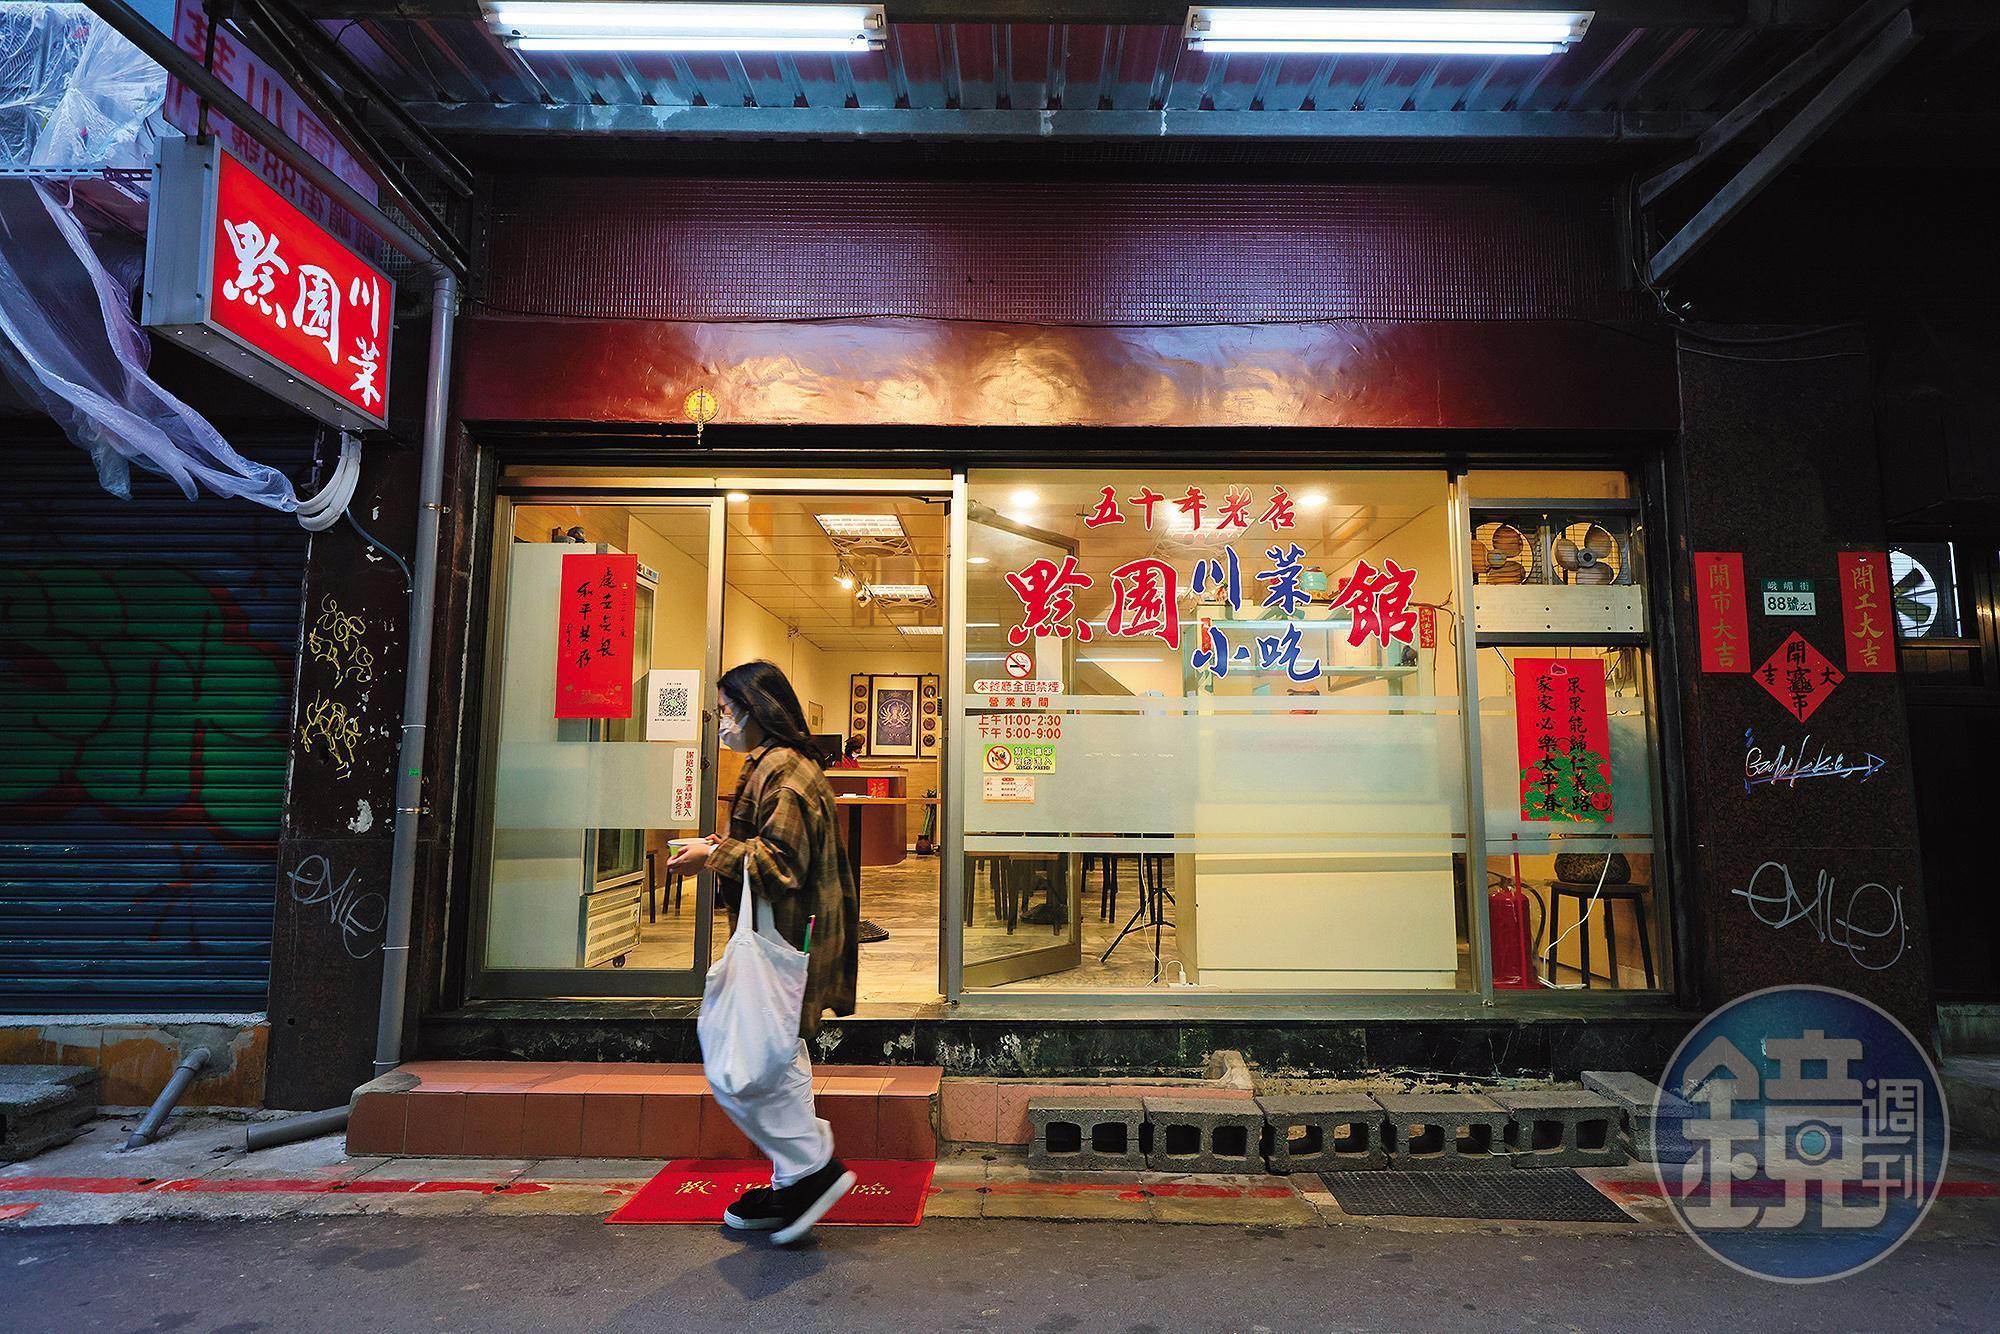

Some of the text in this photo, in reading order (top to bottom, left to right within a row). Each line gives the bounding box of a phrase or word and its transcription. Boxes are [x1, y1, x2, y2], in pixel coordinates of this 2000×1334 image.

[349, 276, 381, 406] 川菜
[1085, 484, 1297, 531] 五十年老店
[1192, 543, 1312, 615] 川菜
[1328, 558, 1418, 649] 館
[1709, 564, 1737, 668] 開市大吉
[1852, 564, 1884, 668] 開工大吉
[1192, 624, 1322, 682] 小吃
[978, 714, 1001, 725] 上午
[978, 727, 1001, 739] 下午
[988, 697, 1049, 707] 營業時間
[1536, 675, 1563, 812] 家家必樂太平春
